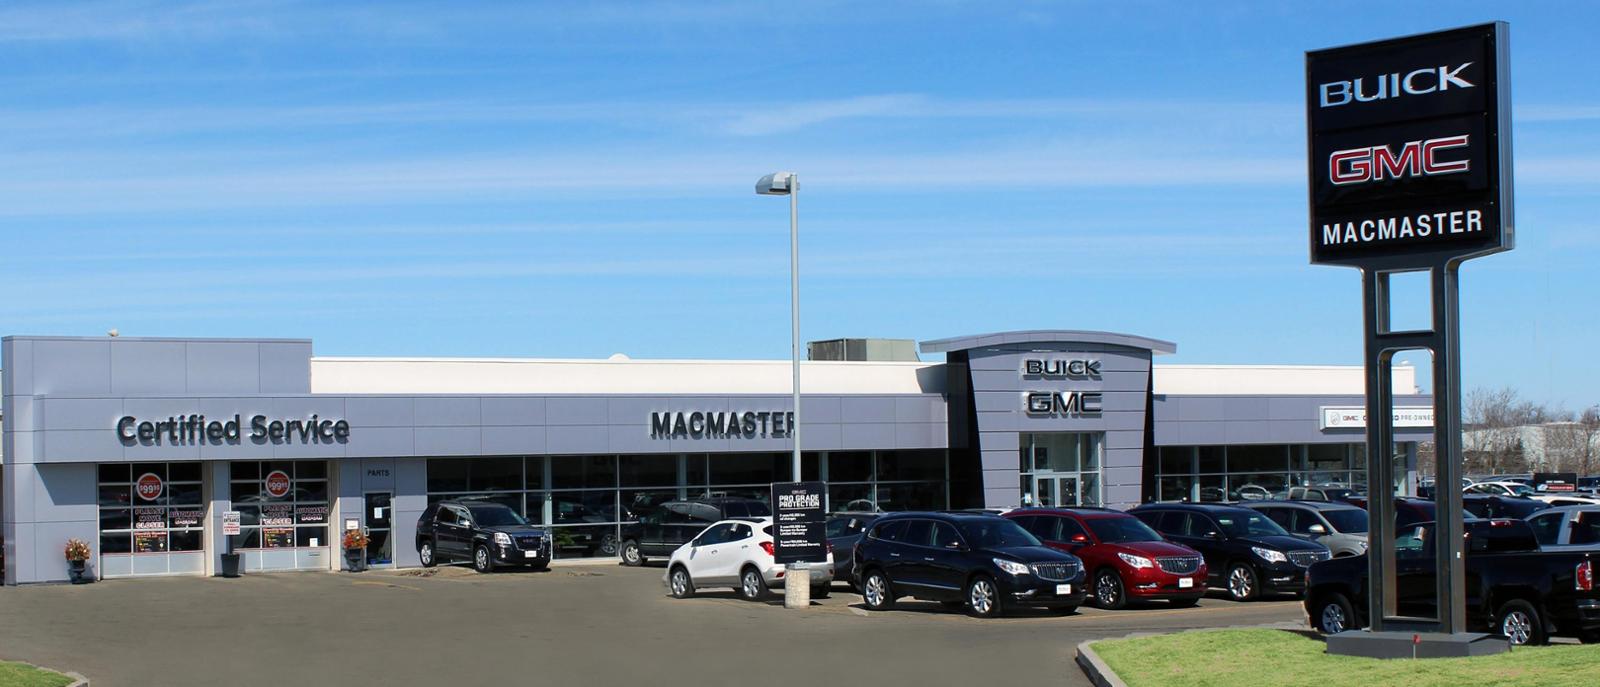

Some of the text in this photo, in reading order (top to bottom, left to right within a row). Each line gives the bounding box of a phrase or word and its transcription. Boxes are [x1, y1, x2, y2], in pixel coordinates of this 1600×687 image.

[1319, 61, 1476, 108] BUICK
[1329, 134, 1471, 186] GMC
[1322, 209, 1483, 246] MACMASTER
[1025, 359, 1102, 377] BUICK
[1026, 391, 1103, 415] GMC
[117, 414, 350, 444] Certified Service
[367, 469, 390, 477] PARTS
[795, 494, 819, 502] GRADE
[135, 521, 165, 529] CLOSER
